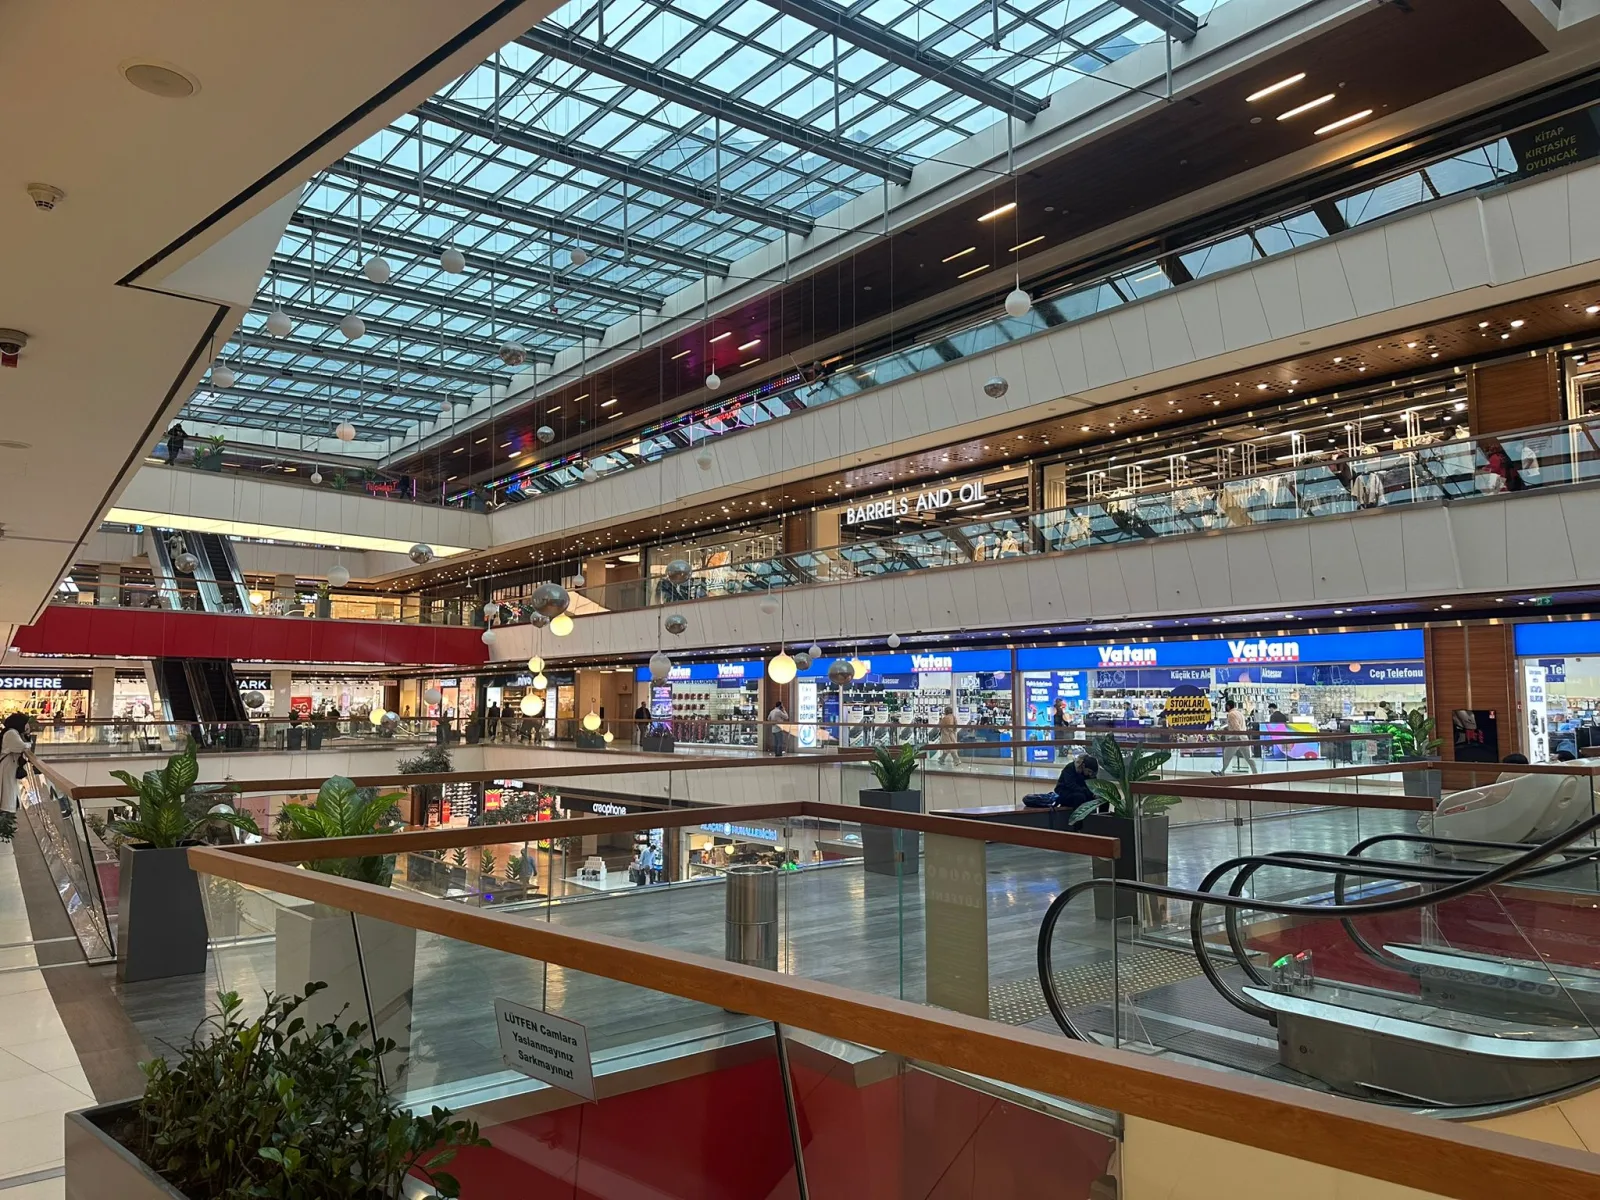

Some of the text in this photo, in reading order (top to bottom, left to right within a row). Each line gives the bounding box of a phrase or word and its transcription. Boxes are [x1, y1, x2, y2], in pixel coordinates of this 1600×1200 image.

[1535, 126, 1564, 143] KİTAP
[1525, 135, 1576, 159] KIRTASİYE
[1526, 148, 1577, 171] OYUNCAK
[846, 481, 988, 525] BARRELS AND OIL
[1098, 646, 1157, 662] Vatan
[1228, 640, 1299, 658] Vatan
[718, 663, 745, 676] Vatan
[911, 654, 953, 669] Vatan
[1170, 670, 1190, 681] Küçük
[1369, 667, 1423, 680] Cep Telefonu
[236, 680, 267, 689] ARK
[1170, 699, 1205, 708] STOKLARI
[504, 1012, 577, 1046] LÜTFEN Camlara
[512, 1031, 574, 1062] Yaslanmayınız
[518, 1050, 574, 1079] Sarkmayınız!
